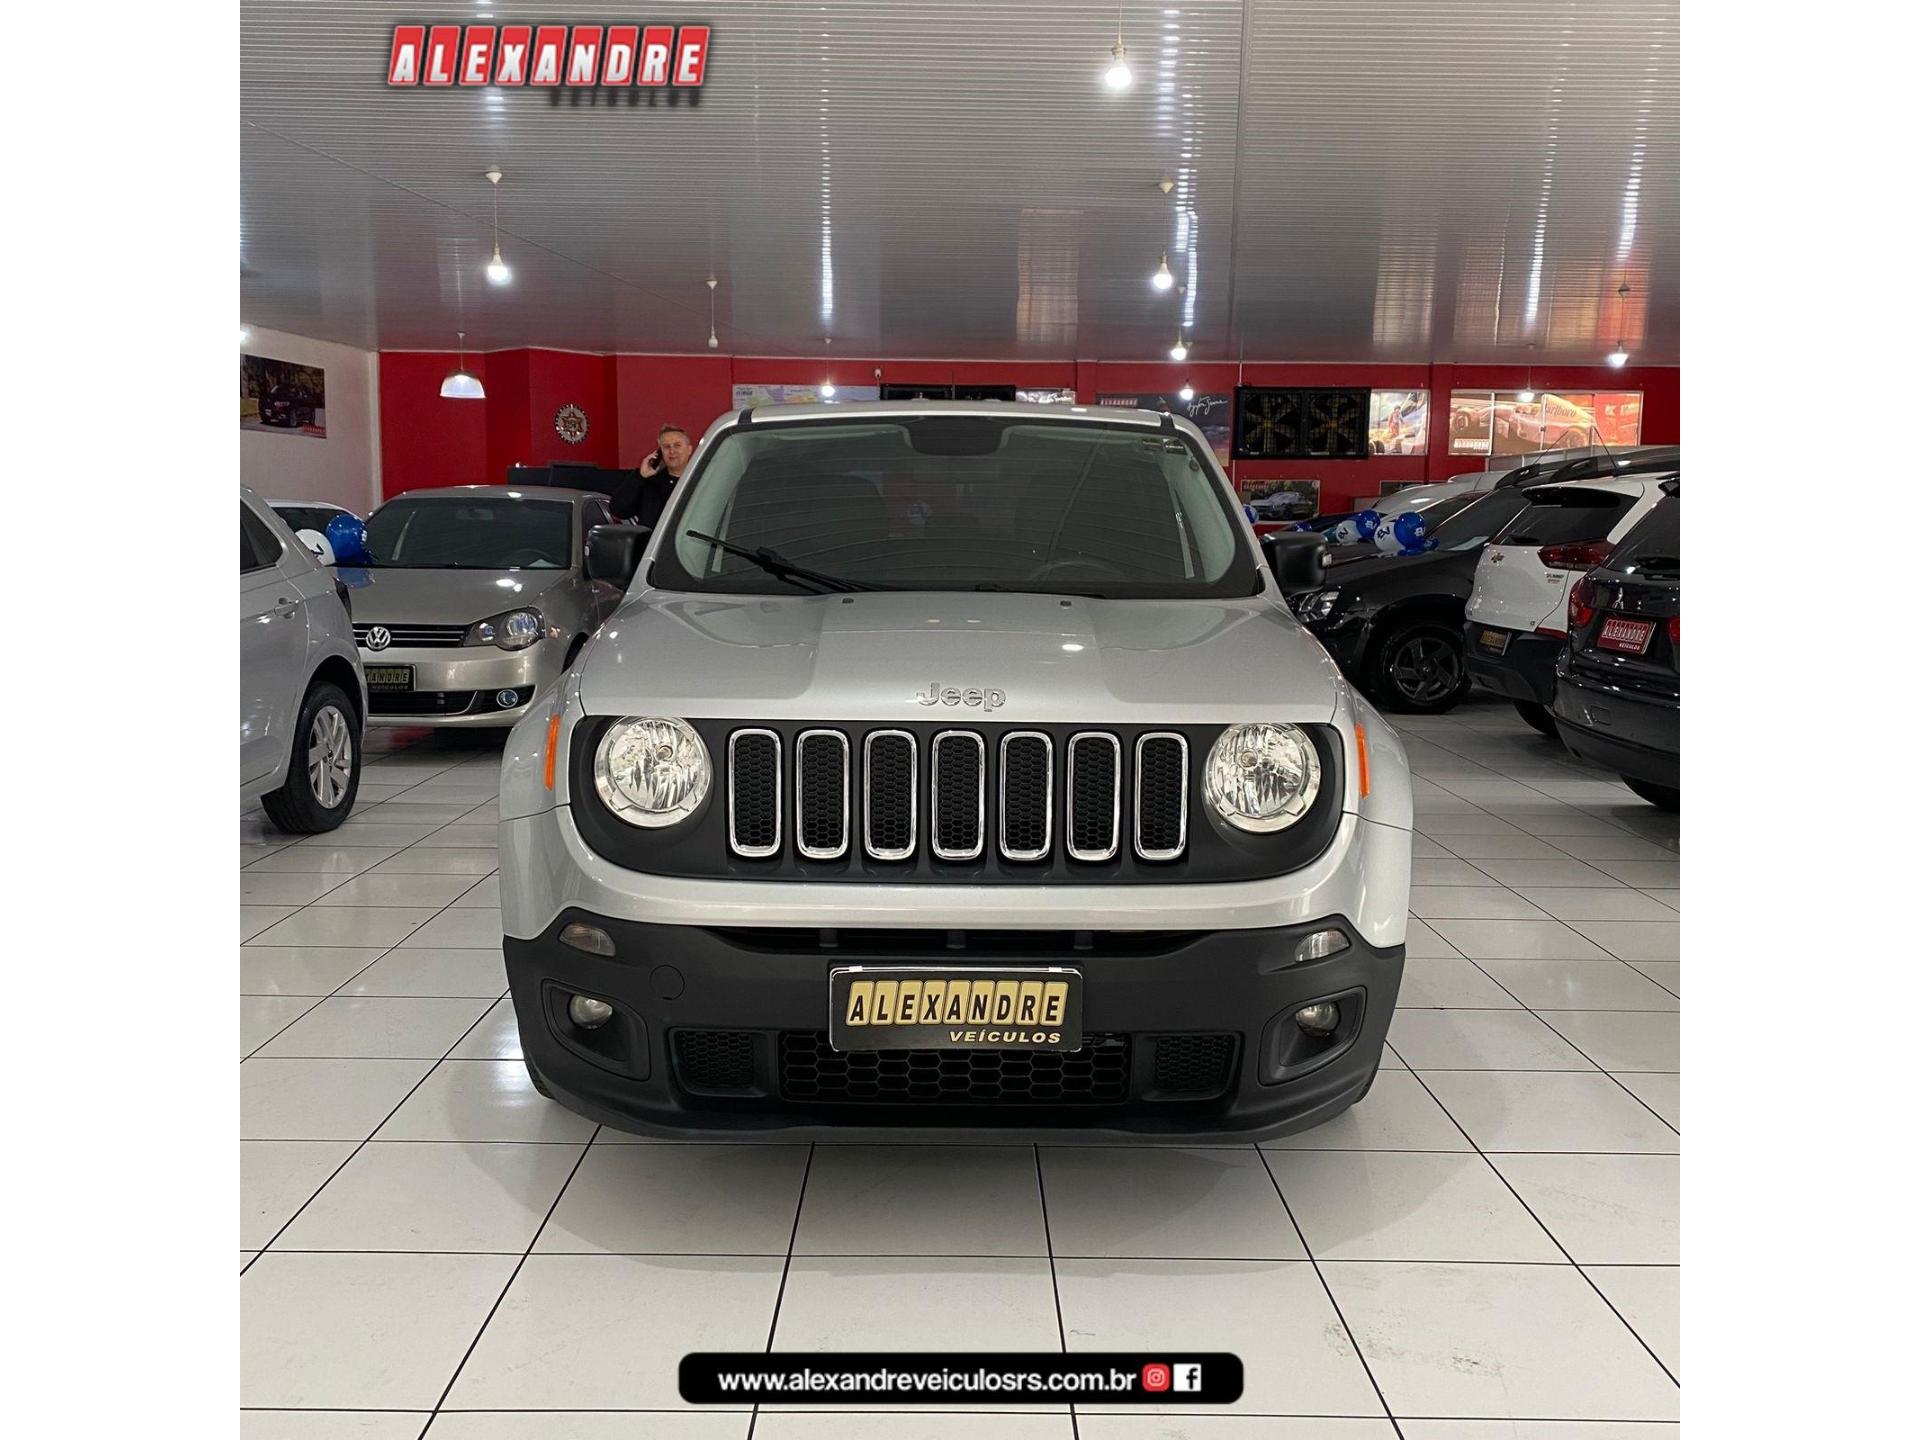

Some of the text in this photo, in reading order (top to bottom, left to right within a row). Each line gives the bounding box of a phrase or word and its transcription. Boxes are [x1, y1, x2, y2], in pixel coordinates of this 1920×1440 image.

[1545, 403, 1577, 418] arlboro
[916, 682, 1006, 712] Jeep
[849, 993, 1060, 1022] ALEXANDRE
[949, 1029, 1062, 1044] VEÍCULOS
